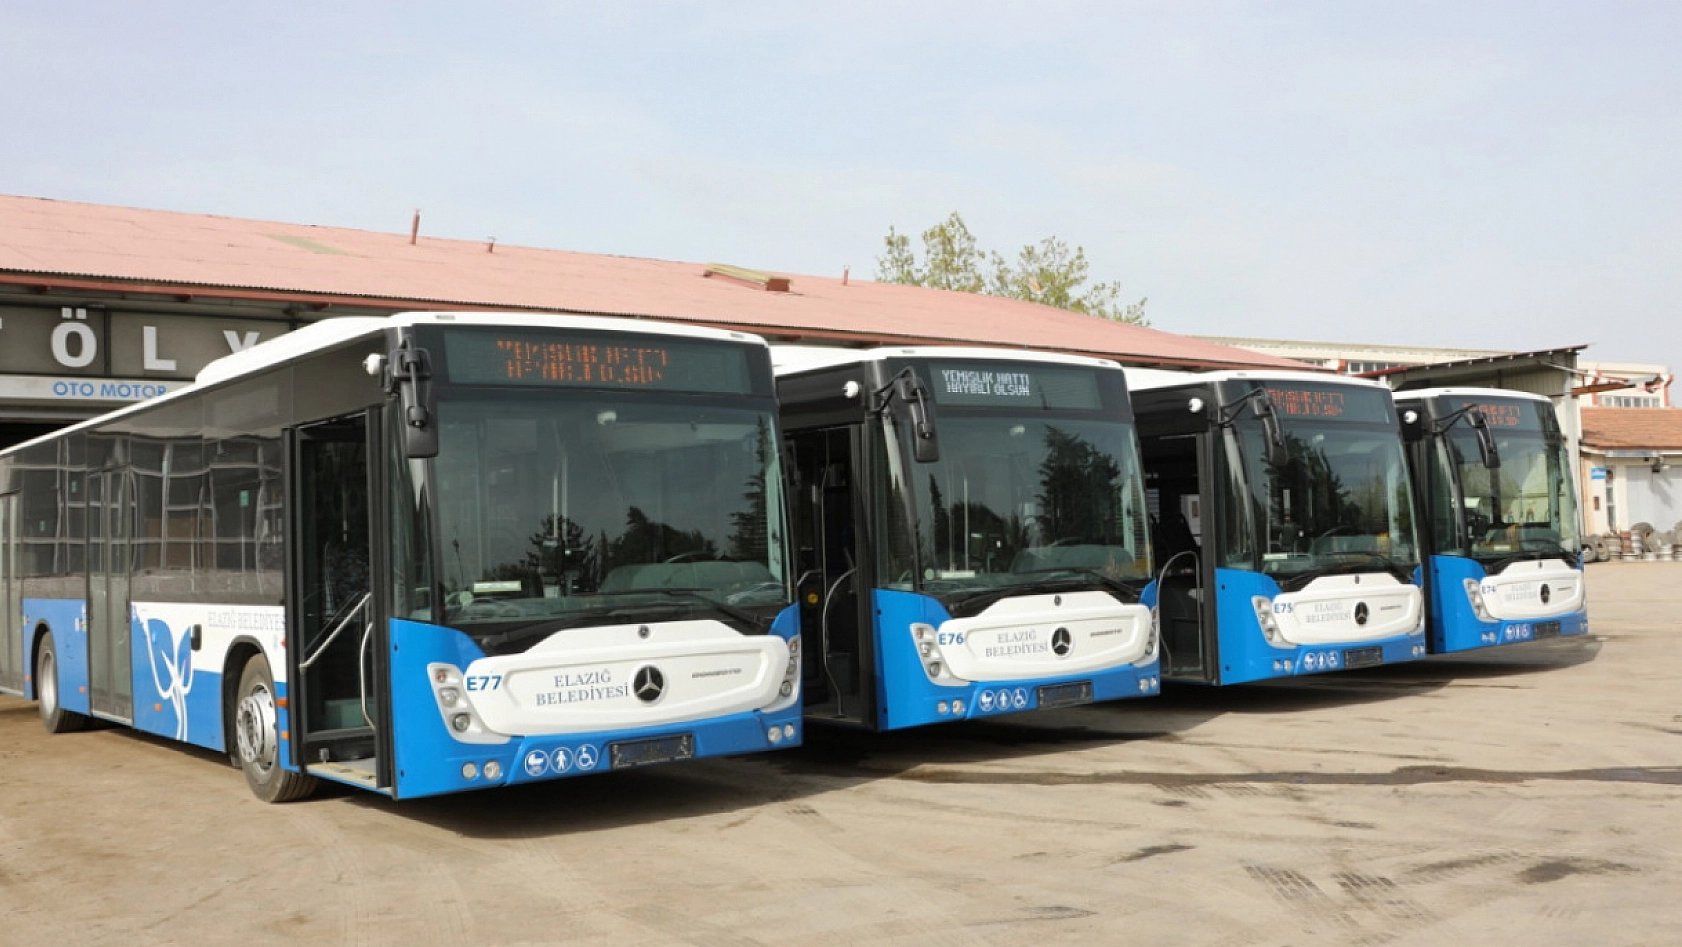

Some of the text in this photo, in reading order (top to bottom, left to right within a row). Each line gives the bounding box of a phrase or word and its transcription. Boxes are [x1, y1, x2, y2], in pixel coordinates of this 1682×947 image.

[53, 381, 167, 398] OTO MOTOR
[1274, 602, 1293, 613] E75
[938, 632, 964, 645] E76
[466, 675, 502, 691] E77
[554, 669, 611, 687] ELAZIĞ
[536, 682, 628, 706] BELEDİYESİ
